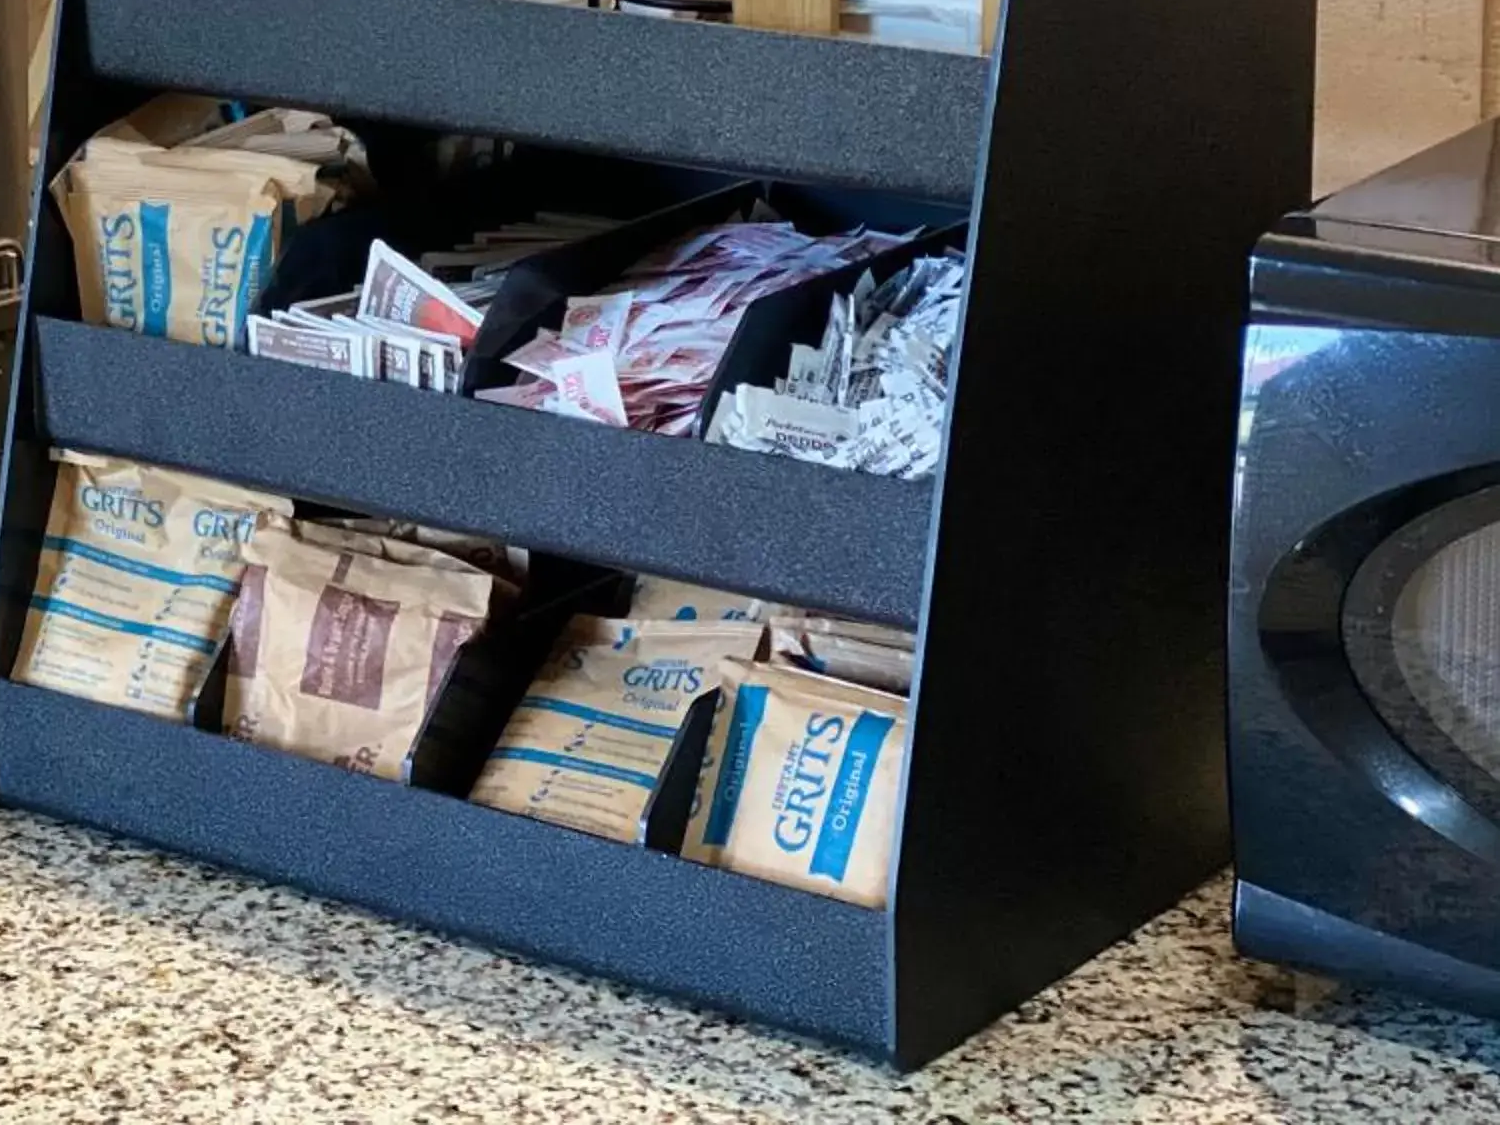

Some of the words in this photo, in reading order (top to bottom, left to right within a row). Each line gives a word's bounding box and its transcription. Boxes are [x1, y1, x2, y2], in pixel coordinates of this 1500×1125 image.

[102, 212, 137, 332] GRITS
[147, 242, 165, 313] Original
[201, 226, 245, 347] GRITS
[81, 485, 164, 528] GRITS
[94, 518, 146, 544] Original
[621, 691, 680, 711] Original
[622, 665, 704, 694] GRITS
[724, 722, 750, 802] Original
[772, 740, 801, 811] INSTANT
[773, 711, 845, 852] GRITS
[831, 750, 868, 831] Original
